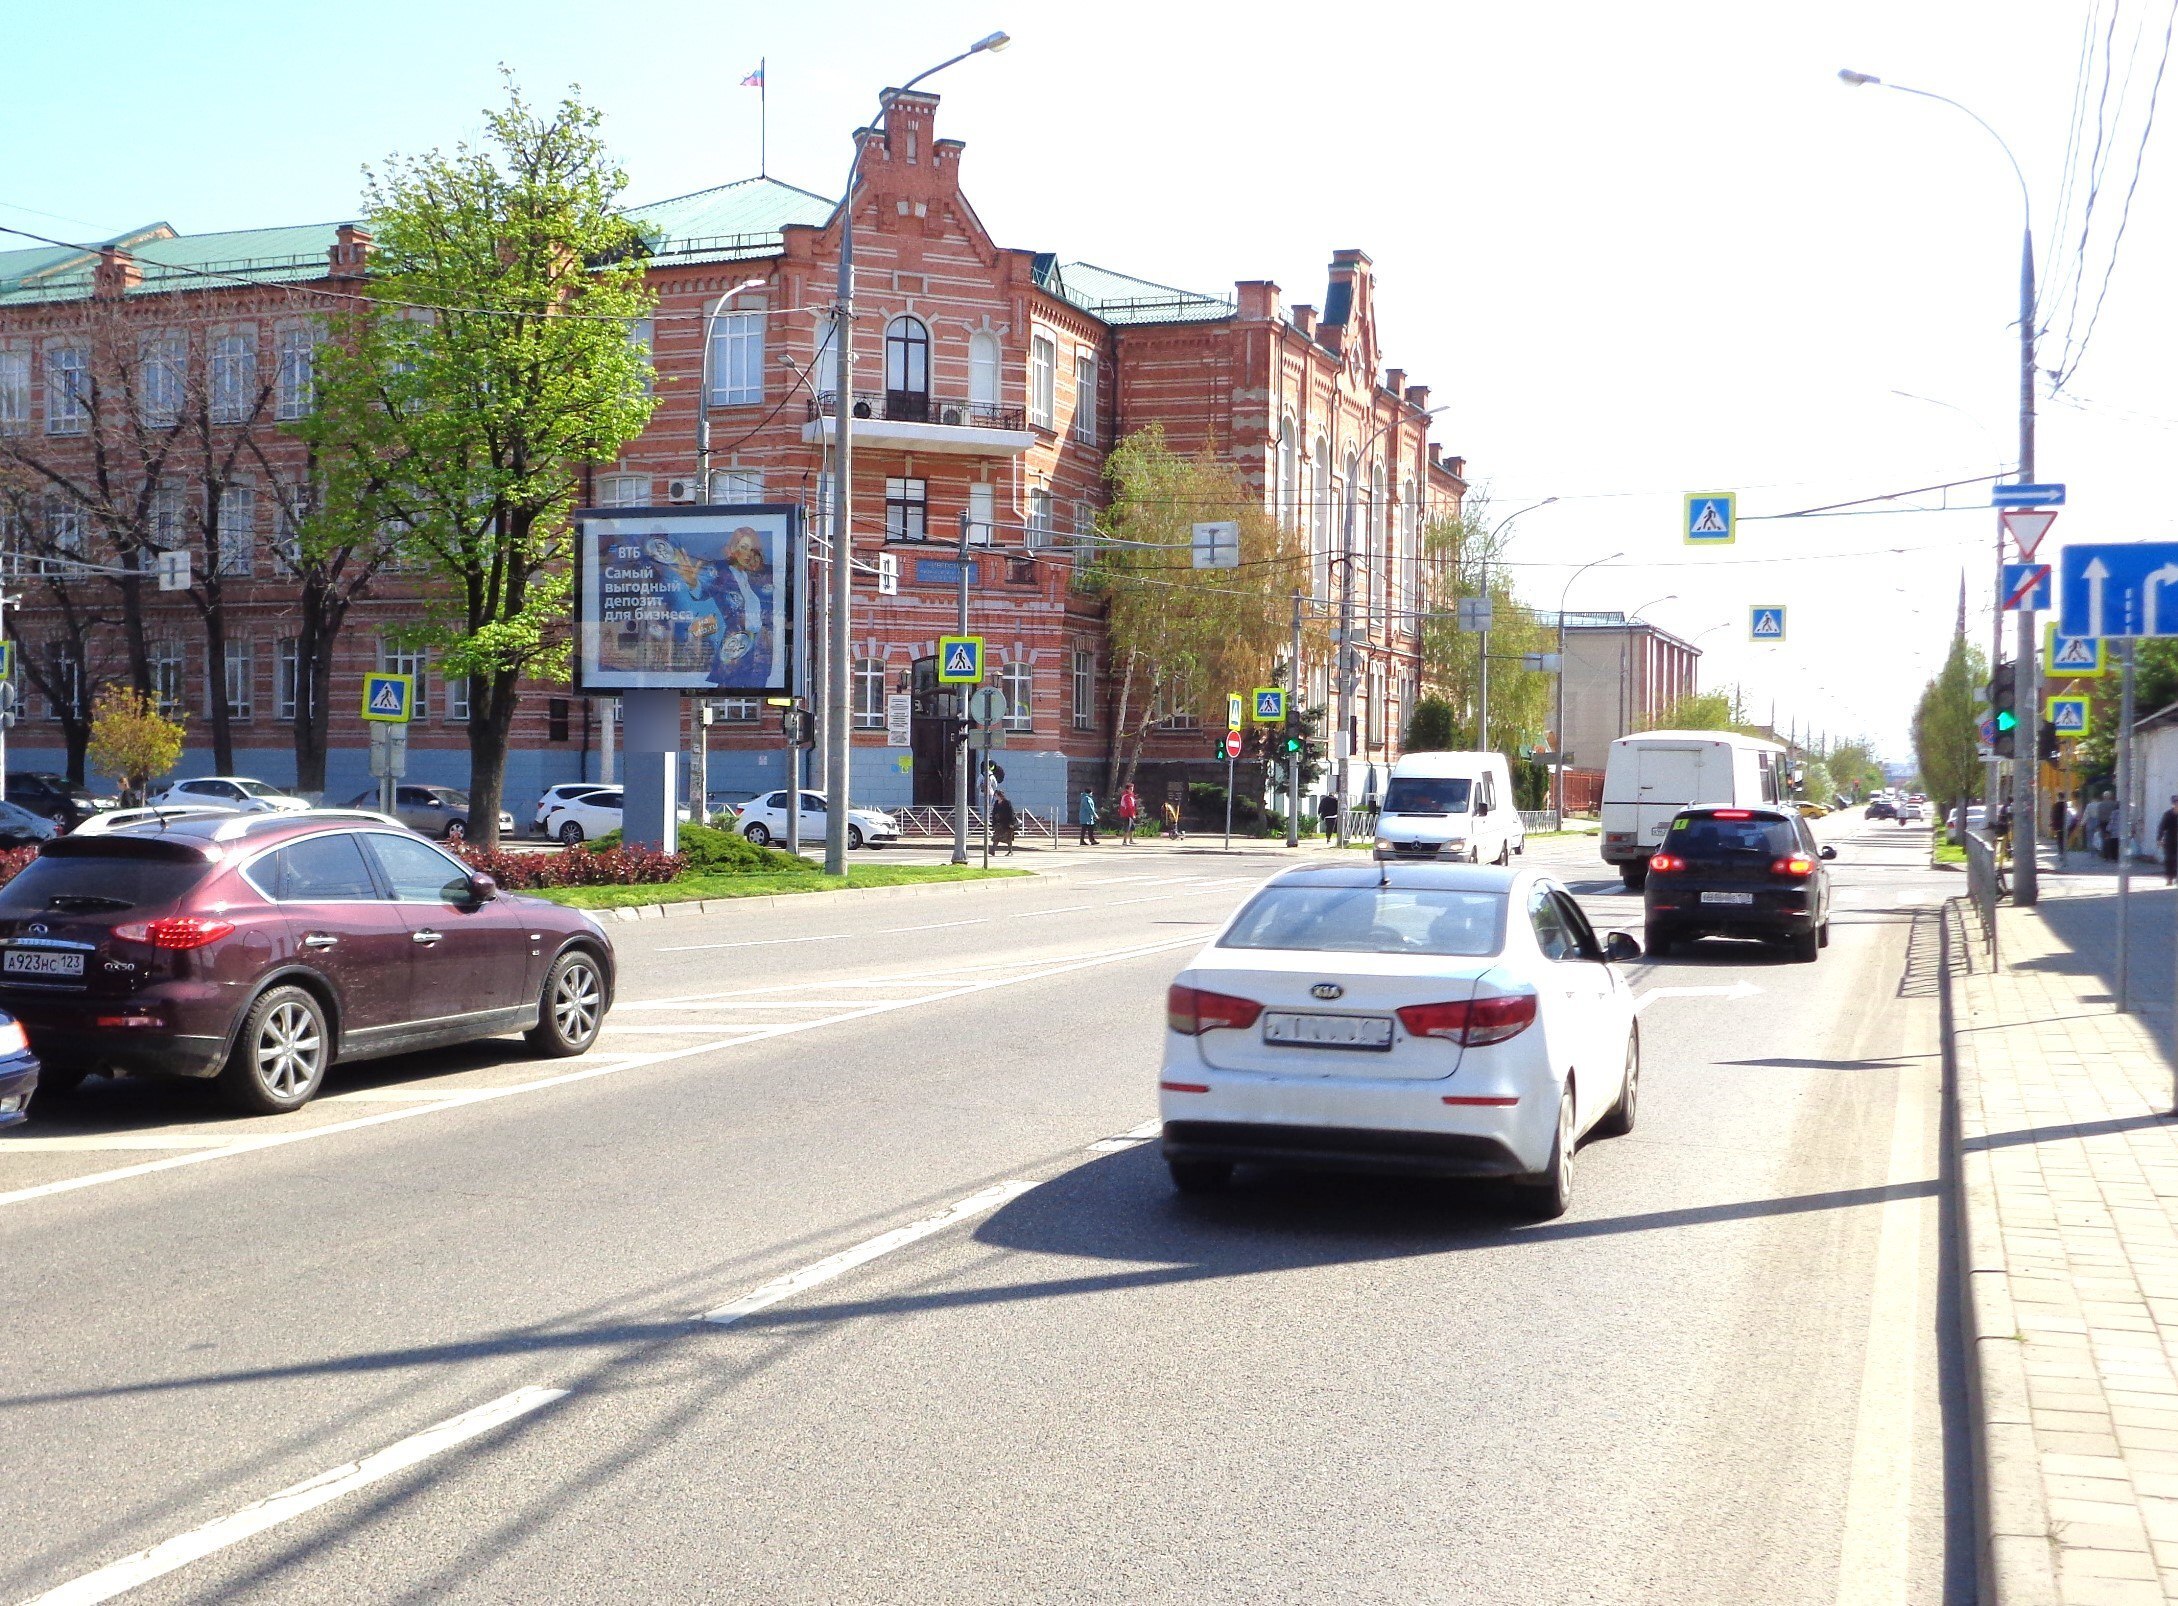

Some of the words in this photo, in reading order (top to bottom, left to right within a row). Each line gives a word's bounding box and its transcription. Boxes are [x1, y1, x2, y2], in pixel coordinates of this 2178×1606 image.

[618, 546, 641, 559] ВТБ
[604, 565, 653, 579] Самый
[604, 579, 681, 595] выгодный
[604, 596, 664, 609] депозит
[604, 610, 631, 623] для
[634, 607, 694, 620] бизнеса
